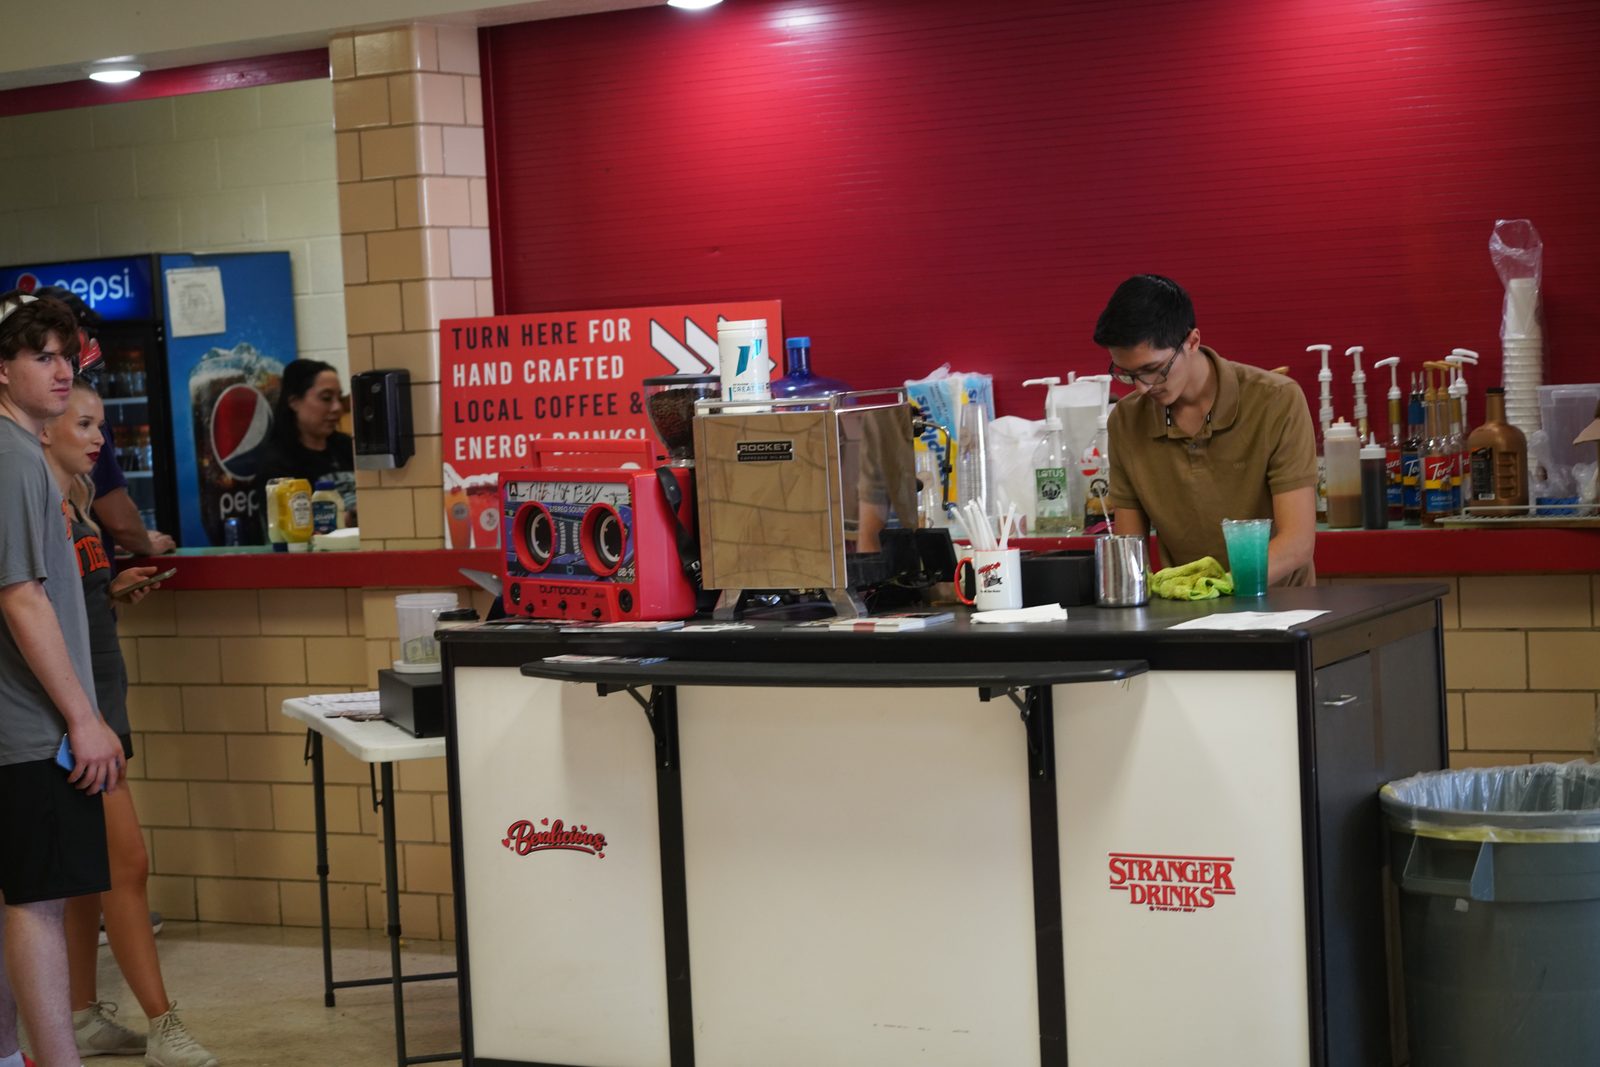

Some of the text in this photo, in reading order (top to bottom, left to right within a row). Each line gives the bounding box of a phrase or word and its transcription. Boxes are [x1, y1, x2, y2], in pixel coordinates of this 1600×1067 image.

[452, 318, 631, 350] TURN HERE FOR
[452, 355, 624, 387] HAND CRAFTED
[732, 384, 766, 393] CREAT
[454, 391, 644, 424] LOCAL COFFEE &
[739, 443, 789, 452] ROCKET
[1037, 469, 1064, 478] LOTUS
[220, 489, 259, 520] pep
[1108, 857, 1235, 890] STRANGER
[1129, 883, 1215, 908] DRINKS
